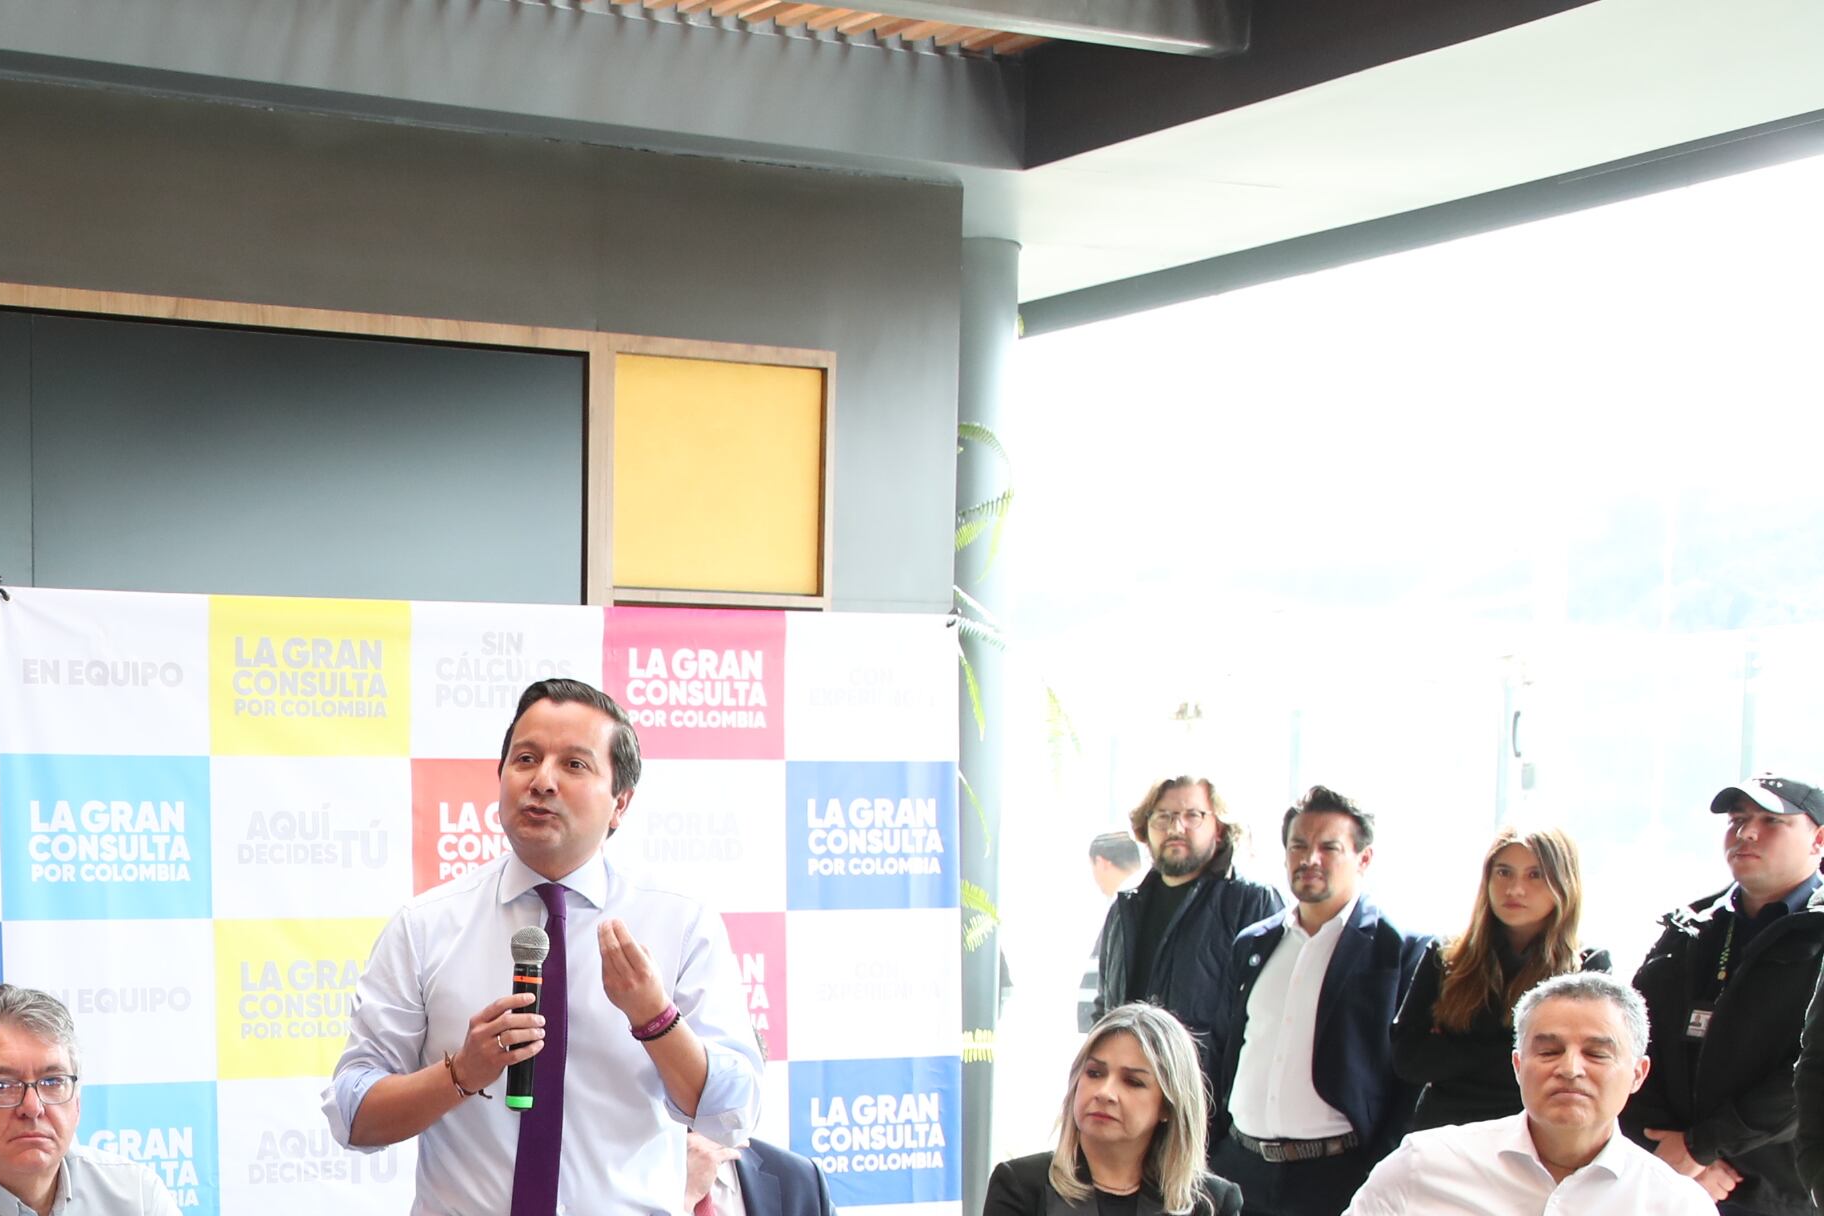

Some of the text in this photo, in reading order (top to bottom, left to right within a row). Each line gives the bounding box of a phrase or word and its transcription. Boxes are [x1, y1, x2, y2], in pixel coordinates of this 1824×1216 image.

[234, 637, 382, 670] LA GRAN
[481, 632, 523, 656] SIN
[22, 659, 184, 687] EN EQUIPO
[628, 648, 764, 680] LA GRAN
[233, 671, 387, 699] CONSULTA
[626, 680, 767, 707] CONSULTA
[234, 699, 387, 718] POR COLOMBIA
[629, 709, 767, 728] POR COLOMBIA
[29, 801, 185, 833] LA GRAN
[246, 803, 331, 842] AQUÍ
[438, 801, 482, 833] LA
[806, 798, 937, 829] LA GRAN
[28, 835, 191, 863] CONSULTA
[238, 844, 338, 865] DECIDES
[336, 819, 389, 870] TÚ
[807, 829, 944, 854] CONSULTA
[31, 863, 191, 883] POR COLOMBIA
[808, 857, 941, 875] POR COLOMBIA
[240, 960, 364, 992] LA GRA
[77, 986, 192, 1014] EQUIPO
[241, 1021, 282, 1039] POR
[810, 1093, 939, 1127] LA GRAN
[89, 1126, 192, 1159] GRAN
[811, 1123, 945, 1153] CONSULTA
[248, 1160, 348, 1184] DECIDES
[852, 1150, 944, 1172] COLOMBIA
